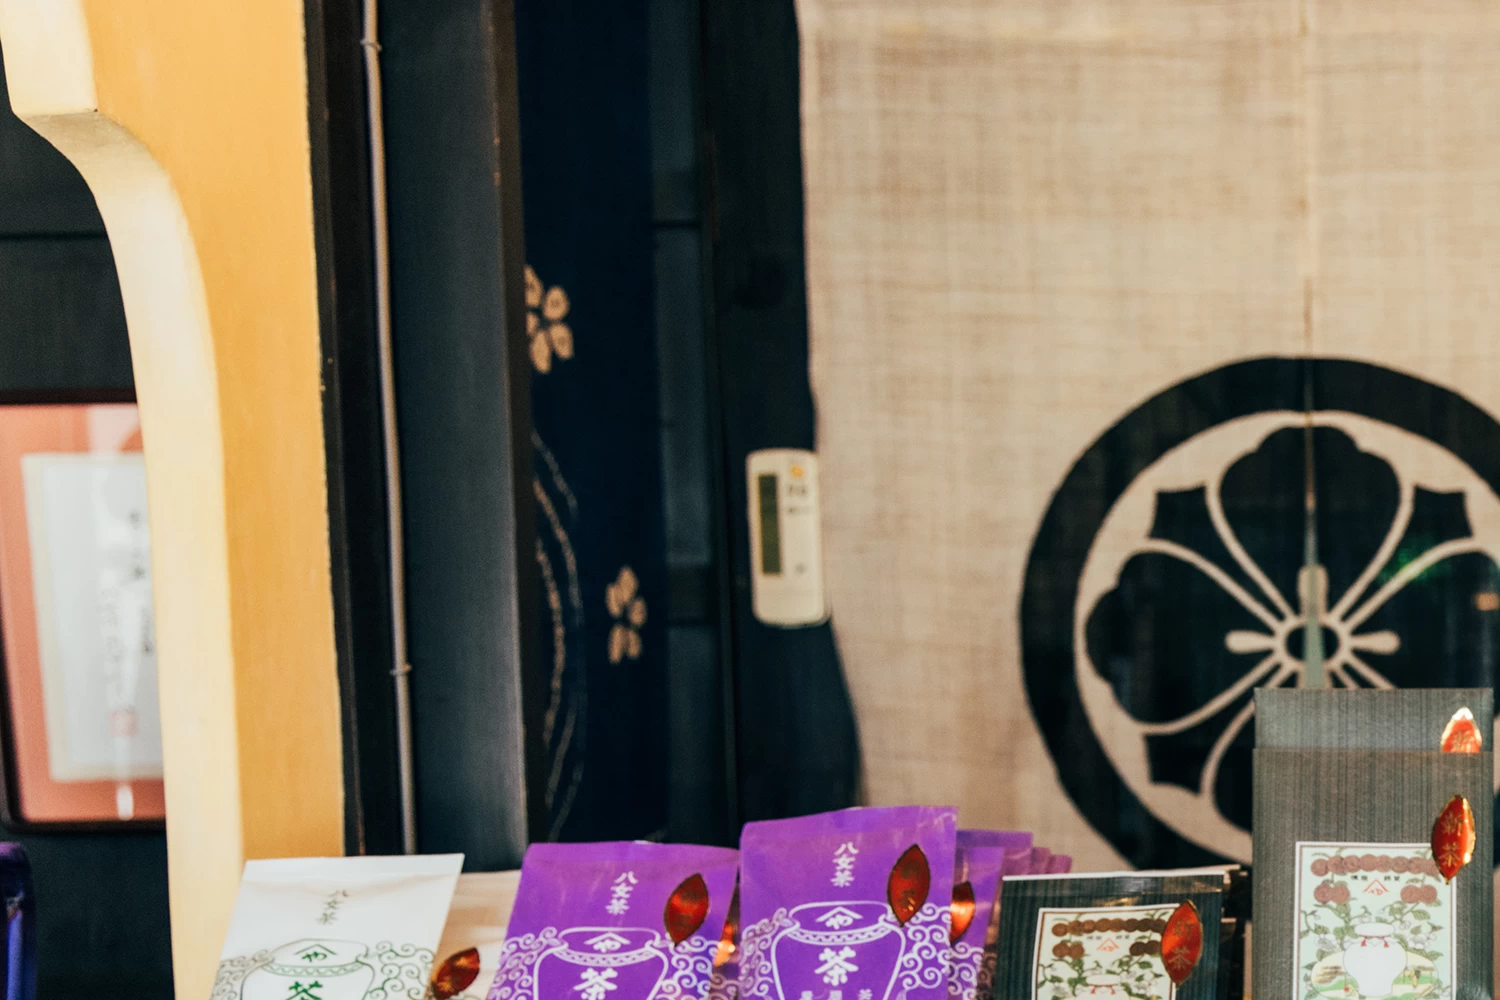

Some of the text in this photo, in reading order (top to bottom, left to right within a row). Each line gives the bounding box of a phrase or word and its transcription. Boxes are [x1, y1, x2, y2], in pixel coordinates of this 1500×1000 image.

[830, 841, 859, 888] 八女茶
[605, 870, 639, 916] 八女茶
[813, 946, 859, 987] 茶
